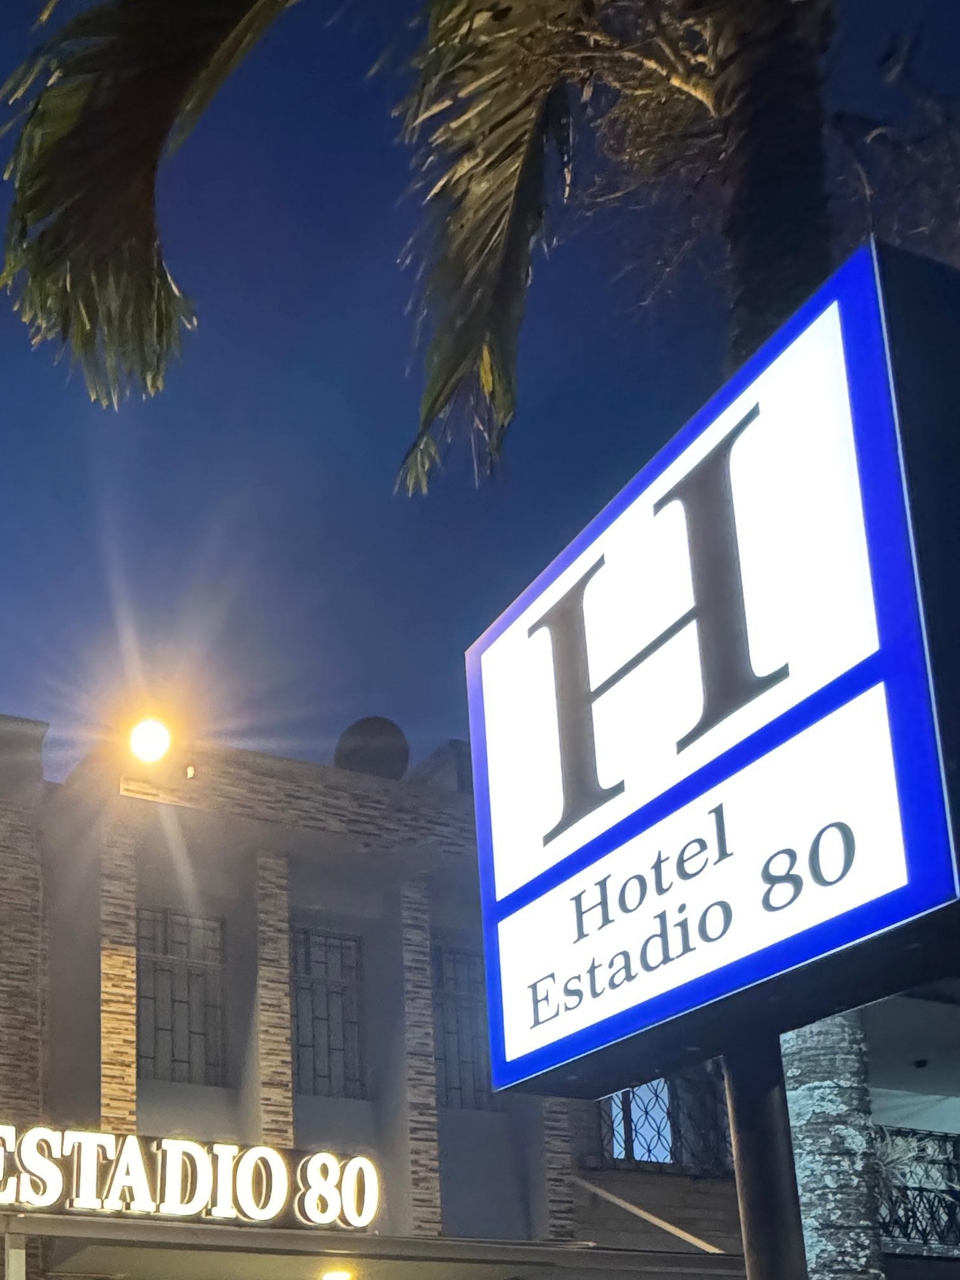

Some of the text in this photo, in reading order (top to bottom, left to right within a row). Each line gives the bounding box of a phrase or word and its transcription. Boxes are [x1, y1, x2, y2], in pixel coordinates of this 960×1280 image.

[527, 402, 790, 847] H
[528, 821, 858, 1030] Estadio 80
[569, 803, 734, 945] Hotel
[298, 1152, 380, 1228] 80
